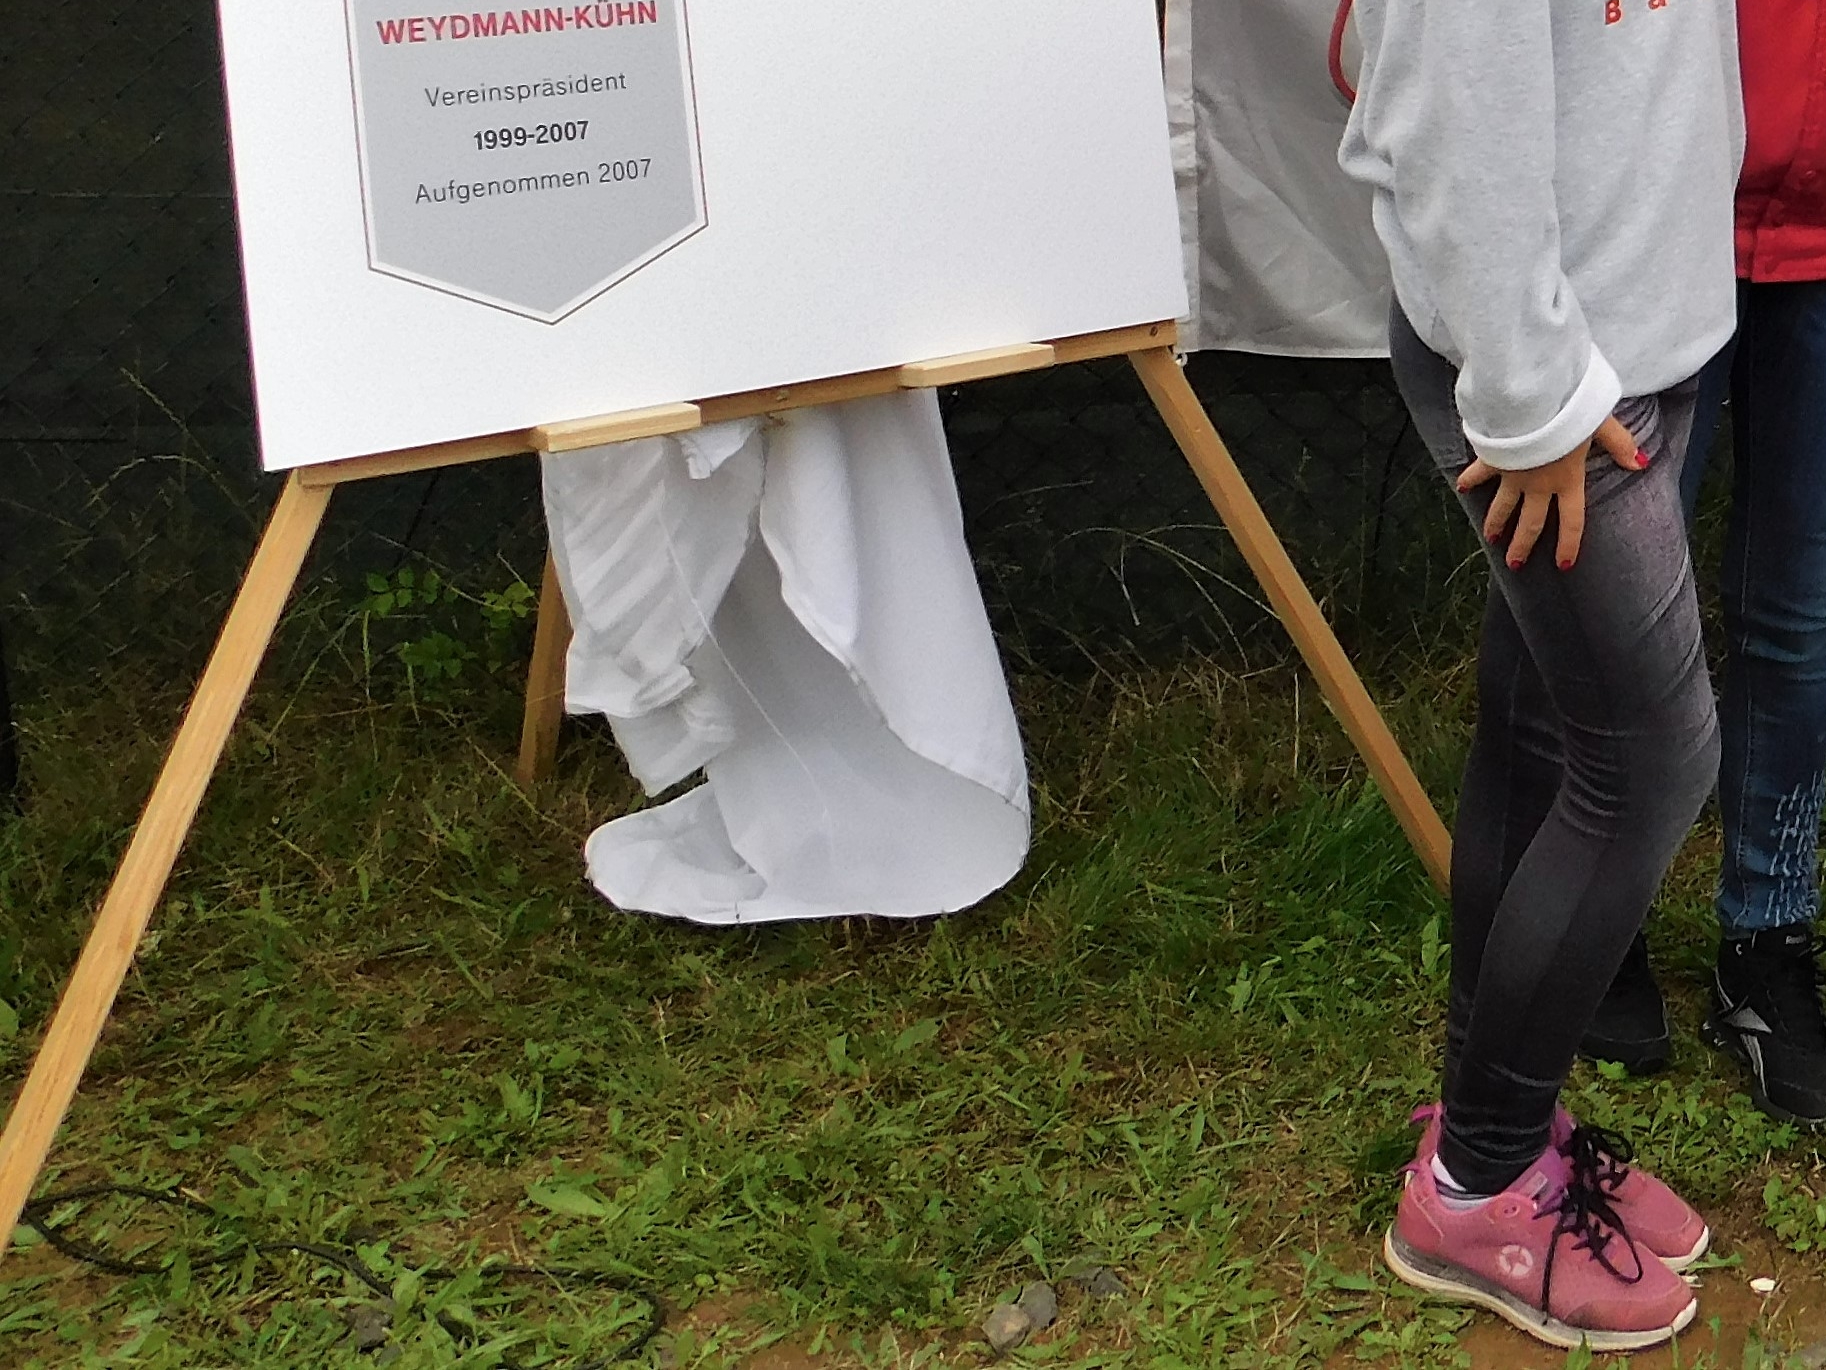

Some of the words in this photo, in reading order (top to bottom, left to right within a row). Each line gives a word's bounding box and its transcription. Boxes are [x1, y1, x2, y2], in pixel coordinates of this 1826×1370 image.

[376, 0, 657, 45] WEYDMANN-KÜHN
[425, 73, 627, 108] Vereinspräsident
[474, 121, 589, 150] 1999-2007
[415, 170, 590, 204] Aufgenommen
[598, 159, 652, 183] 2007
